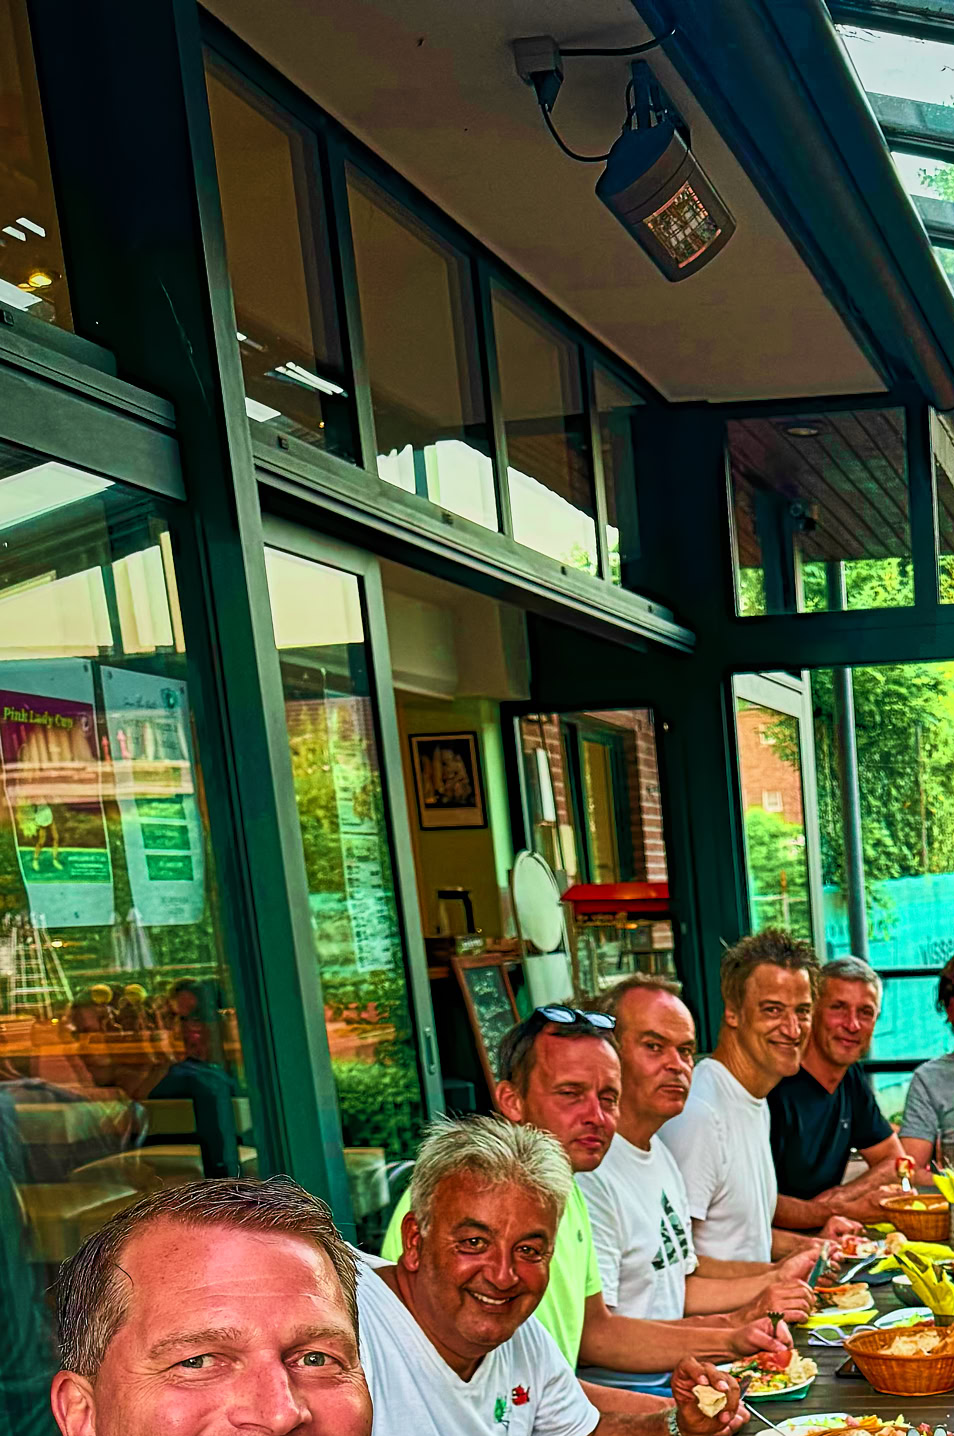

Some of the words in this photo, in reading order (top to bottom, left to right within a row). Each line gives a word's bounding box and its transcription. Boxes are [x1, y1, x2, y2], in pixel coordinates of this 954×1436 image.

[4, 706, 28, 722] Pink
[30, 710, 52, 728] Lady
[55, 714, 73, 730] Cup
